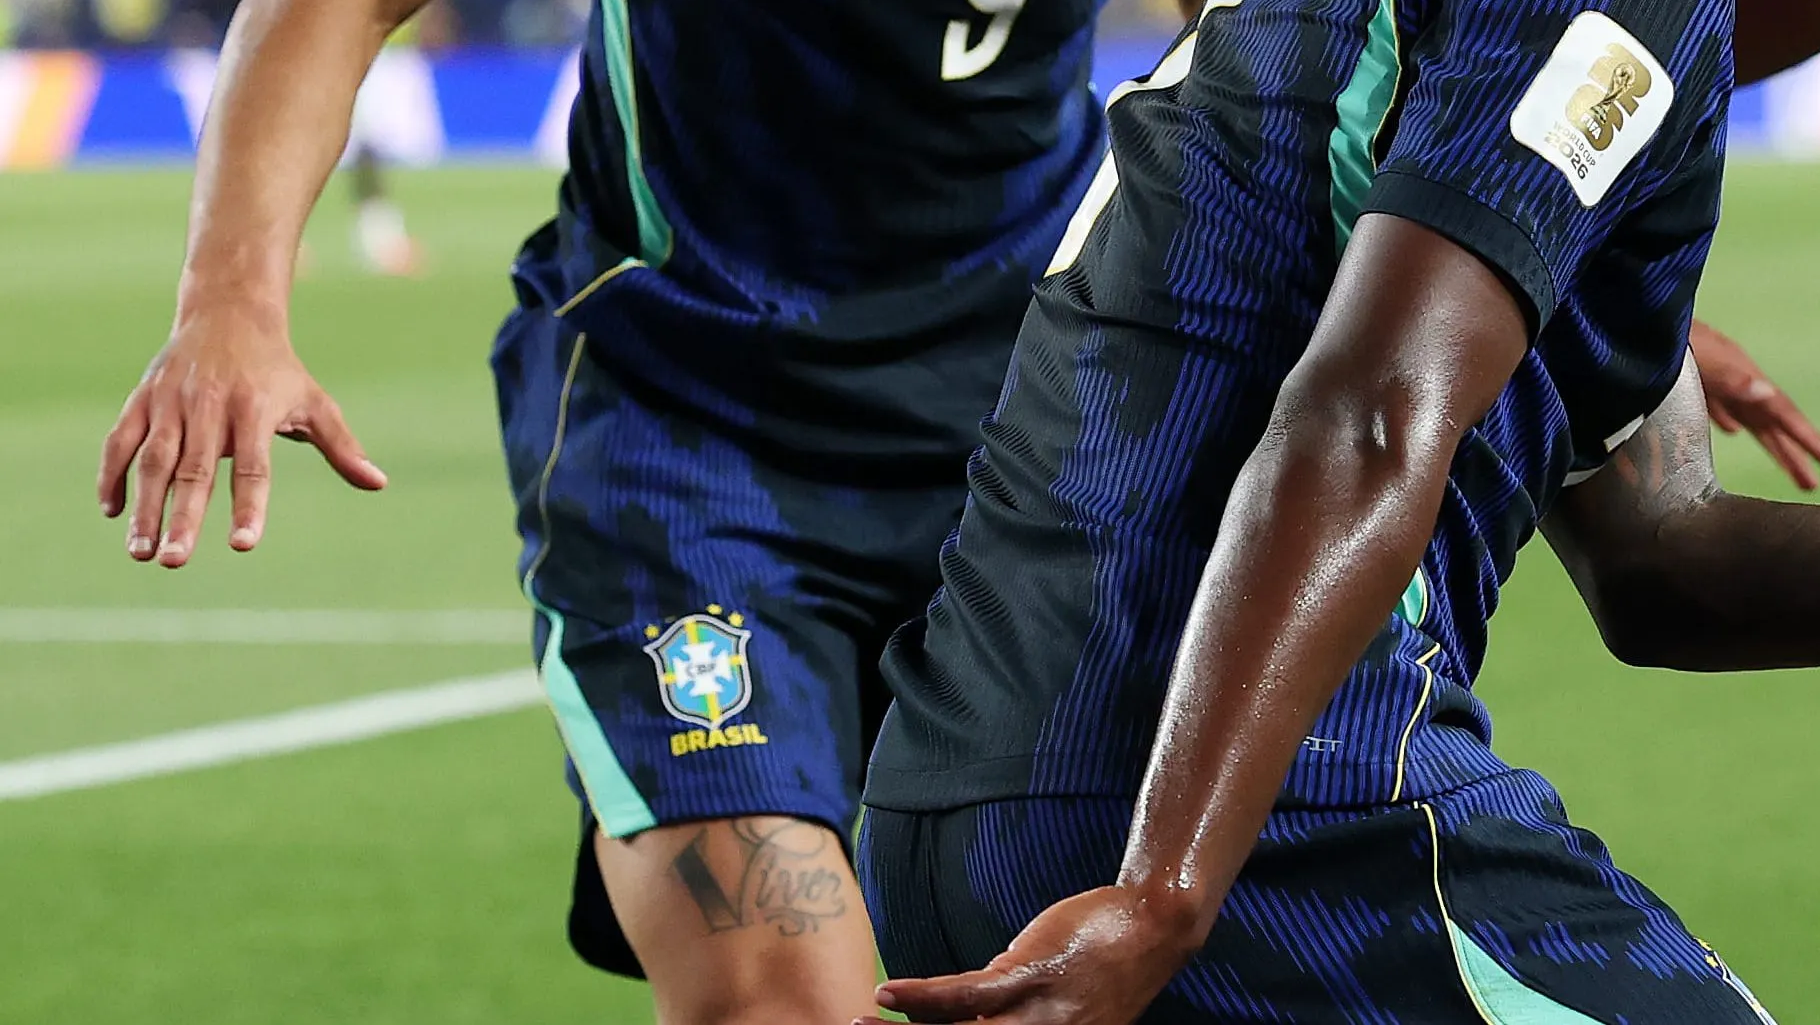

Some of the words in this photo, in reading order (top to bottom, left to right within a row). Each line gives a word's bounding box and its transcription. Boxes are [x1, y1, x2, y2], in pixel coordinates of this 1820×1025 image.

[1543, 131, 1589, 179] 2026
[1582, 149, 1596, 166] CUP
[670, 723, 769, 756] BRASIL
